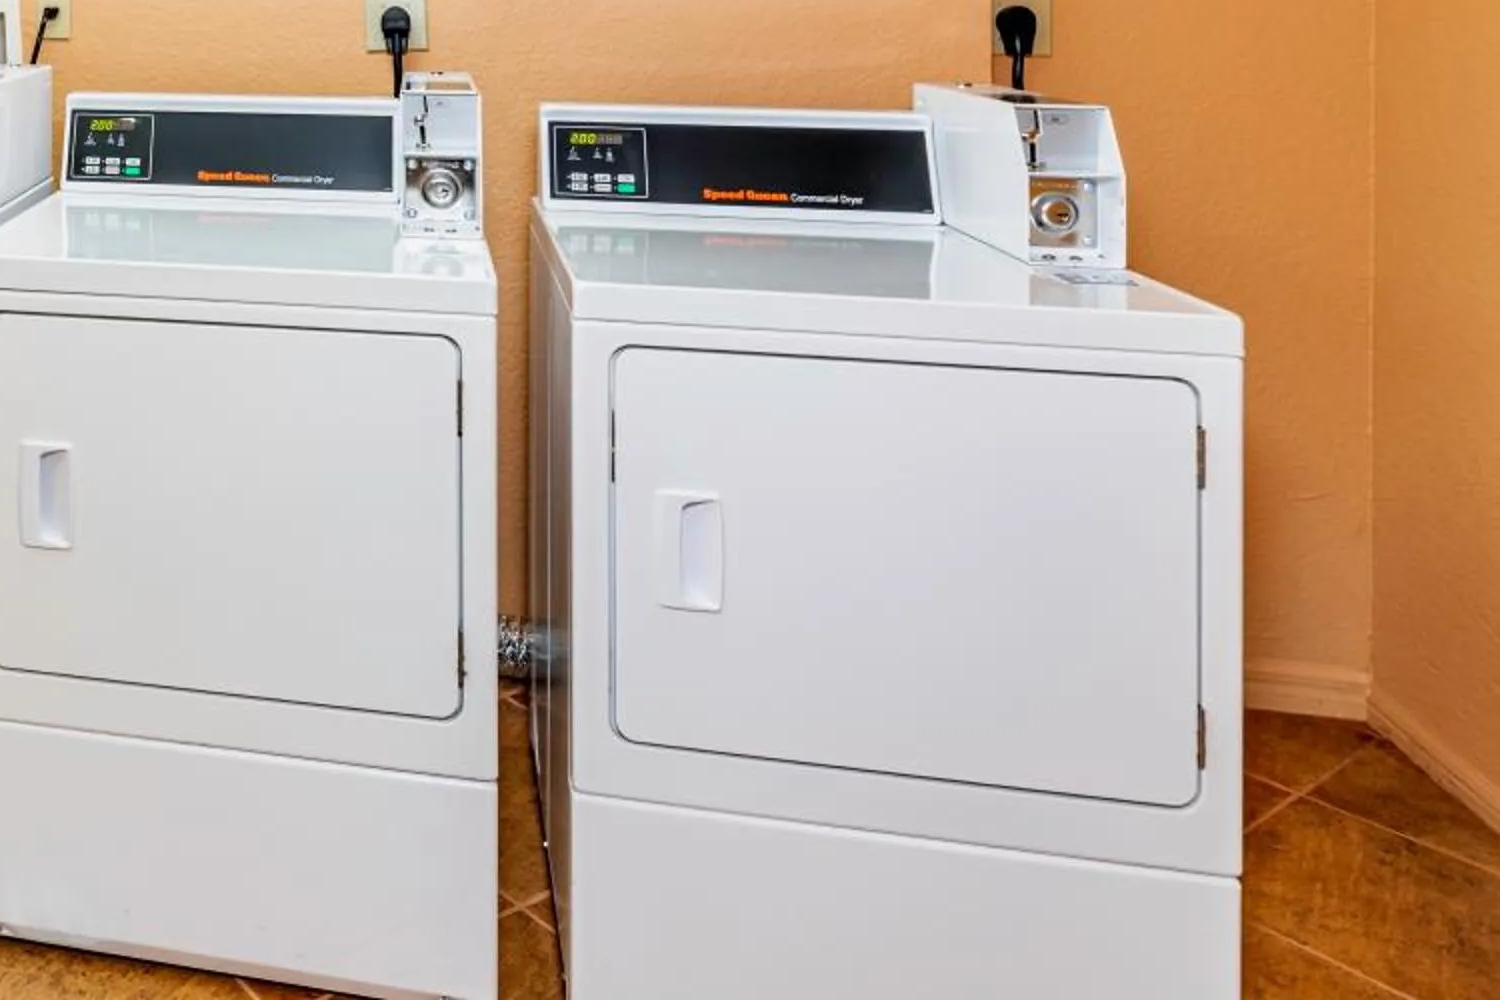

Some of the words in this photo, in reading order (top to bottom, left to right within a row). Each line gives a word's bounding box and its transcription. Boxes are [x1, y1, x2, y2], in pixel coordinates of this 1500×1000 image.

[313, 175, 335, 186] Dryer
[703, 189, 744, 201] Speed
[746, 190, 788, 202] Queen
[789, 192, 839, 203] Commercial
[840, 194, 864, 206] Dryer
